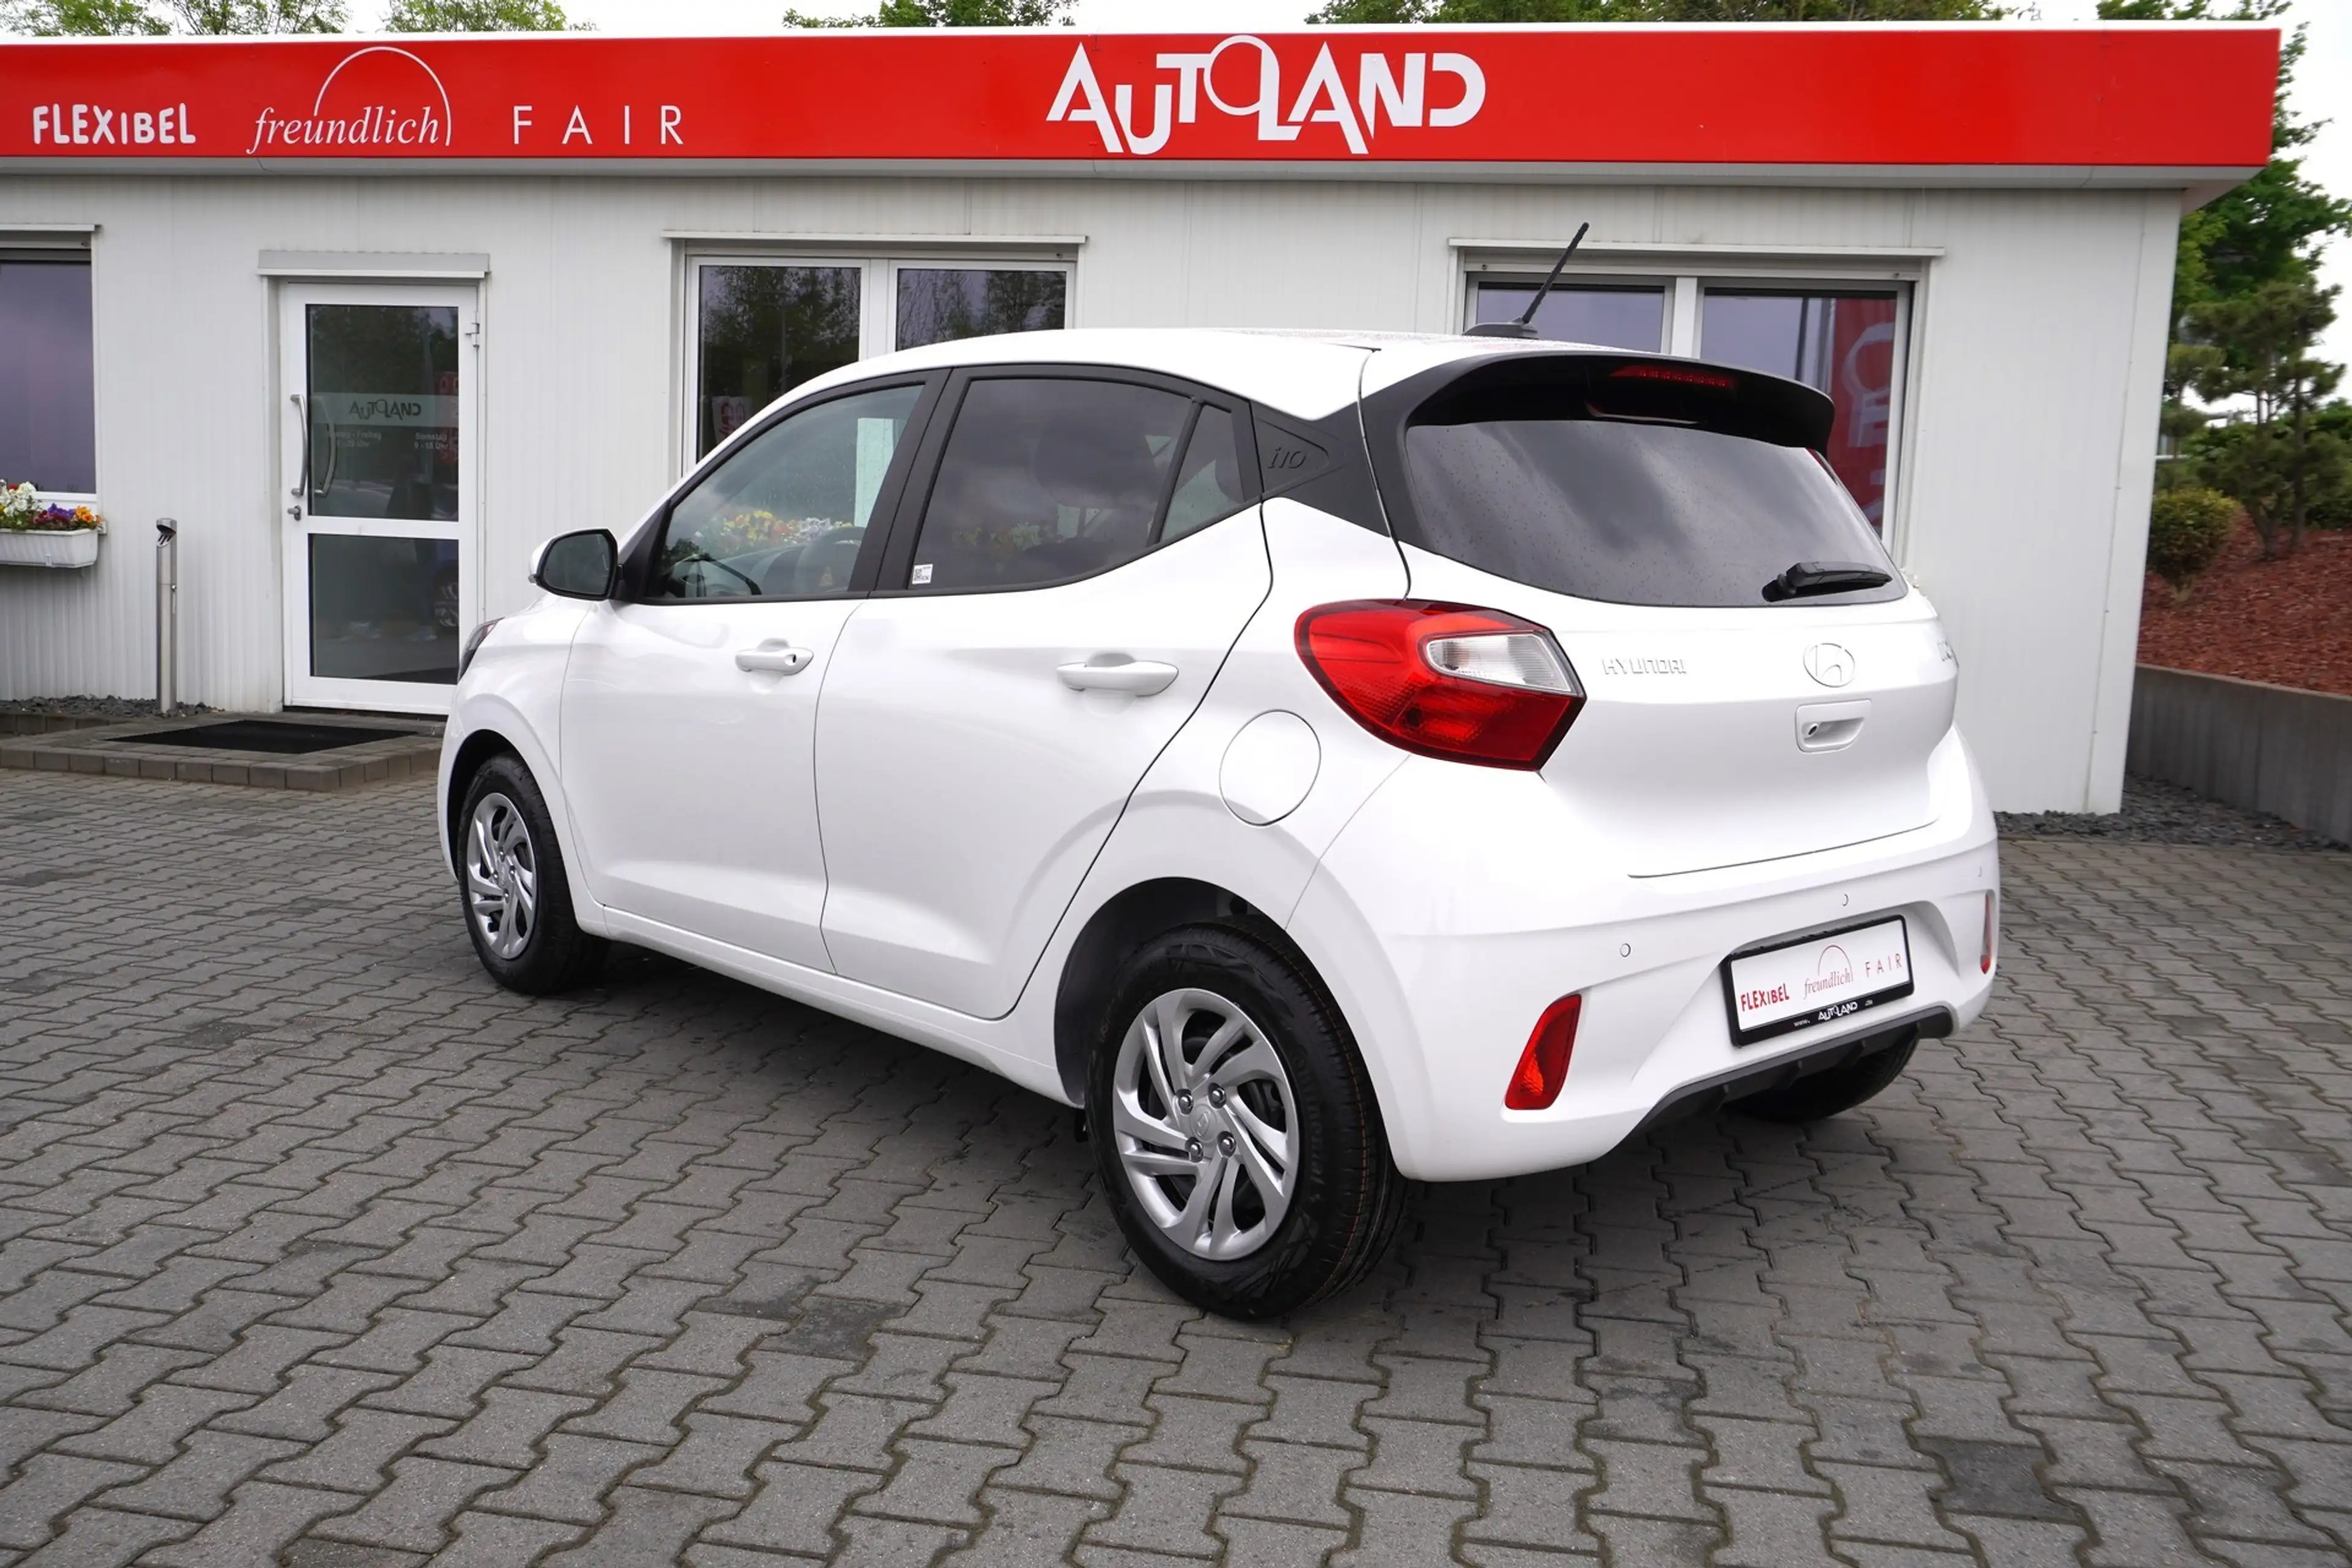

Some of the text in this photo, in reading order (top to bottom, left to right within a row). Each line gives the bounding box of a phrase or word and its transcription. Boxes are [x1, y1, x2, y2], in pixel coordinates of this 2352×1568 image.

[1046, 34, 1486, 155] AUTOLAND
[33, 102, 684, 154] FLEXIBEL freundlich FAIR
[1600, 657, 1687, 675] HYUNDAI
[1740, 952, 1902, 1012] FLEXIBEL freundlich FAIR
